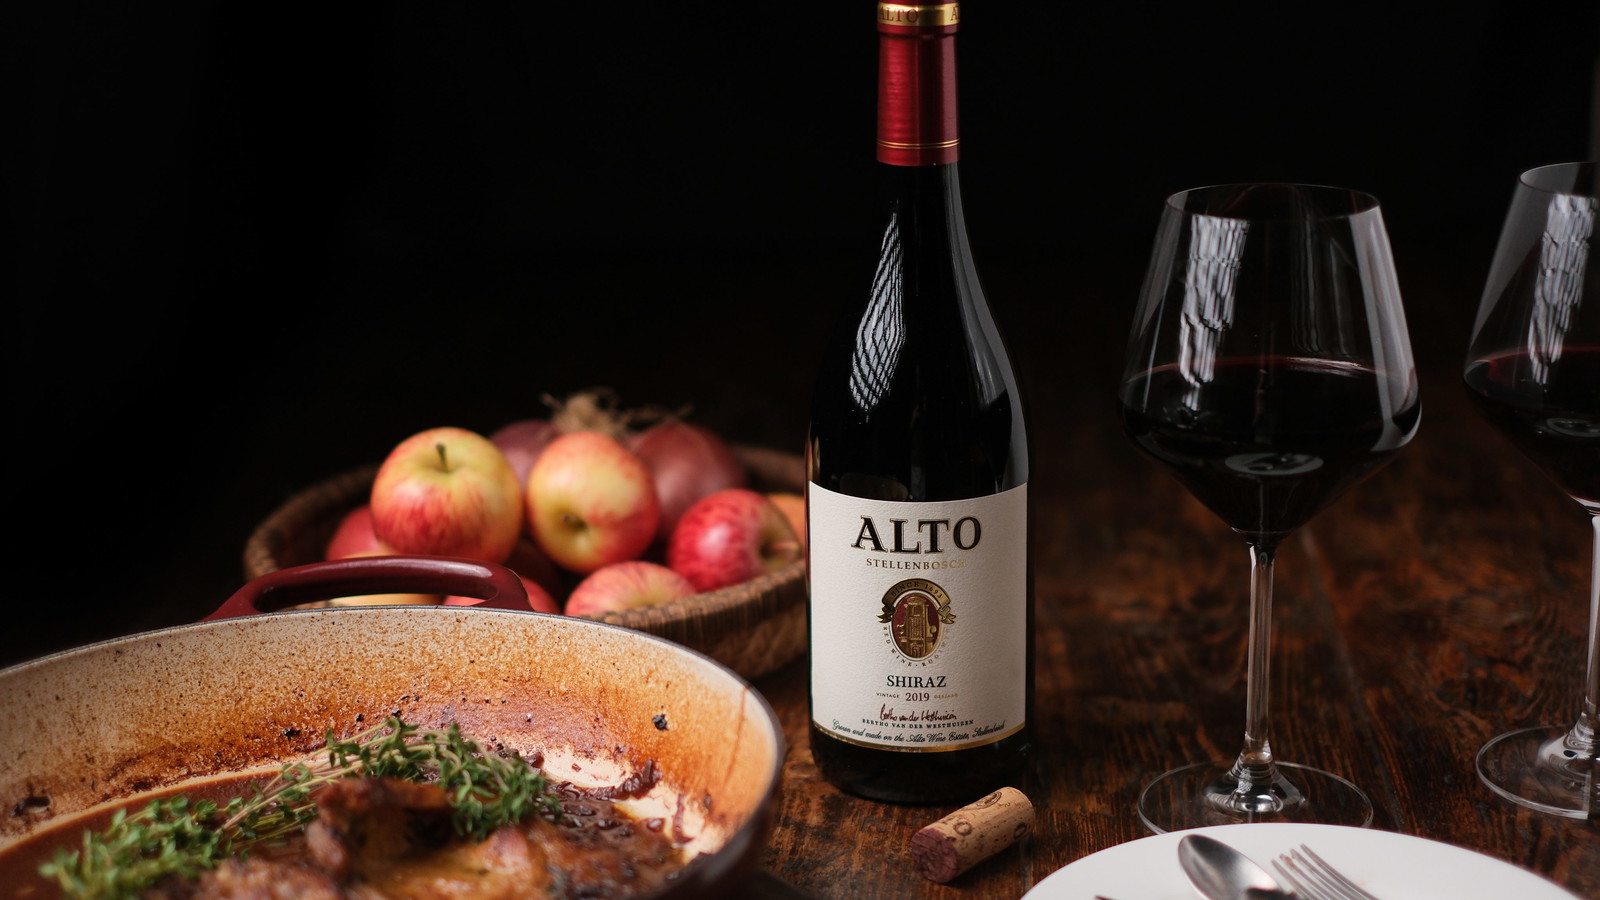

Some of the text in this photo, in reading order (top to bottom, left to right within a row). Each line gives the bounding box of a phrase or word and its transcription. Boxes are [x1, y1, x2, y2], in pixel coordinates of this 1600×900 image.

[879, 6, 919, 24] ALTO
[850, 514, 982, 554] ALTO
[866, 558, 968, 571] STELLENBOSCH
[890, 581, 920, 598] SINCE
[891, 649, 912, 667] WINE
[886, 675, 947, 688] SHIRAZ
[905, 692, 930, 702] 2019
[862, 719, 889, 727] BERTHO
[926, 719, 974, 729] WESTHUIZEN
[852, 728, 866, 737] and
[865, 730, 882, 739] made
[893, 733, 904, 742] the
[905, 733, 926, 743] Alto
[926, 732, 946, 743] Wine
